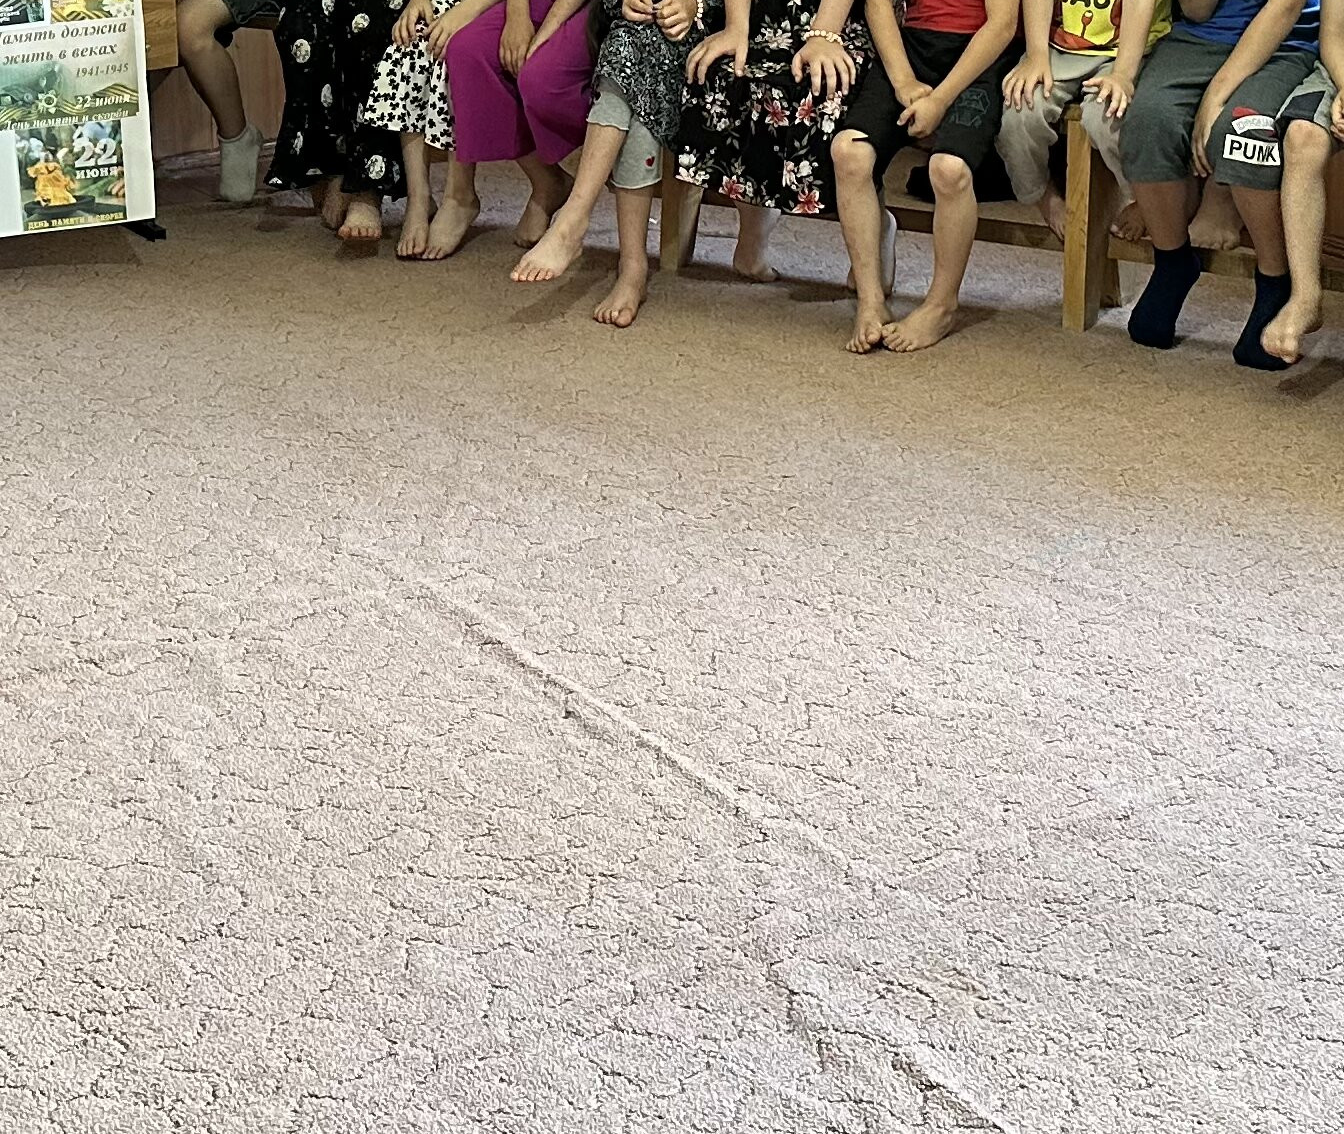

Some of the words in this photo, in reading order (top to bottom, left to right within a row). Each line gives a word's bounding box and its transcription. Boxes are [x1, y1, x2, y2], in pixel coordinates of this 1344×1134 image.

[61, 22, 127, 39] должна
[2, 51, 54, 66] жить
[59, 50, 67, 60] в
[71, 44, 118, 59] веках
[76, 62, 129, 78] 1941-1945
[76, 96, 91, 109] 22
[32, 115, 79, 128] памяти
[91, 109, 129, 122] скорби
[73, 137, 118, 167] 22
[1229, 139, 1277, 163] PUNK
[76, 167, 118, 180] ИЮНЯ
